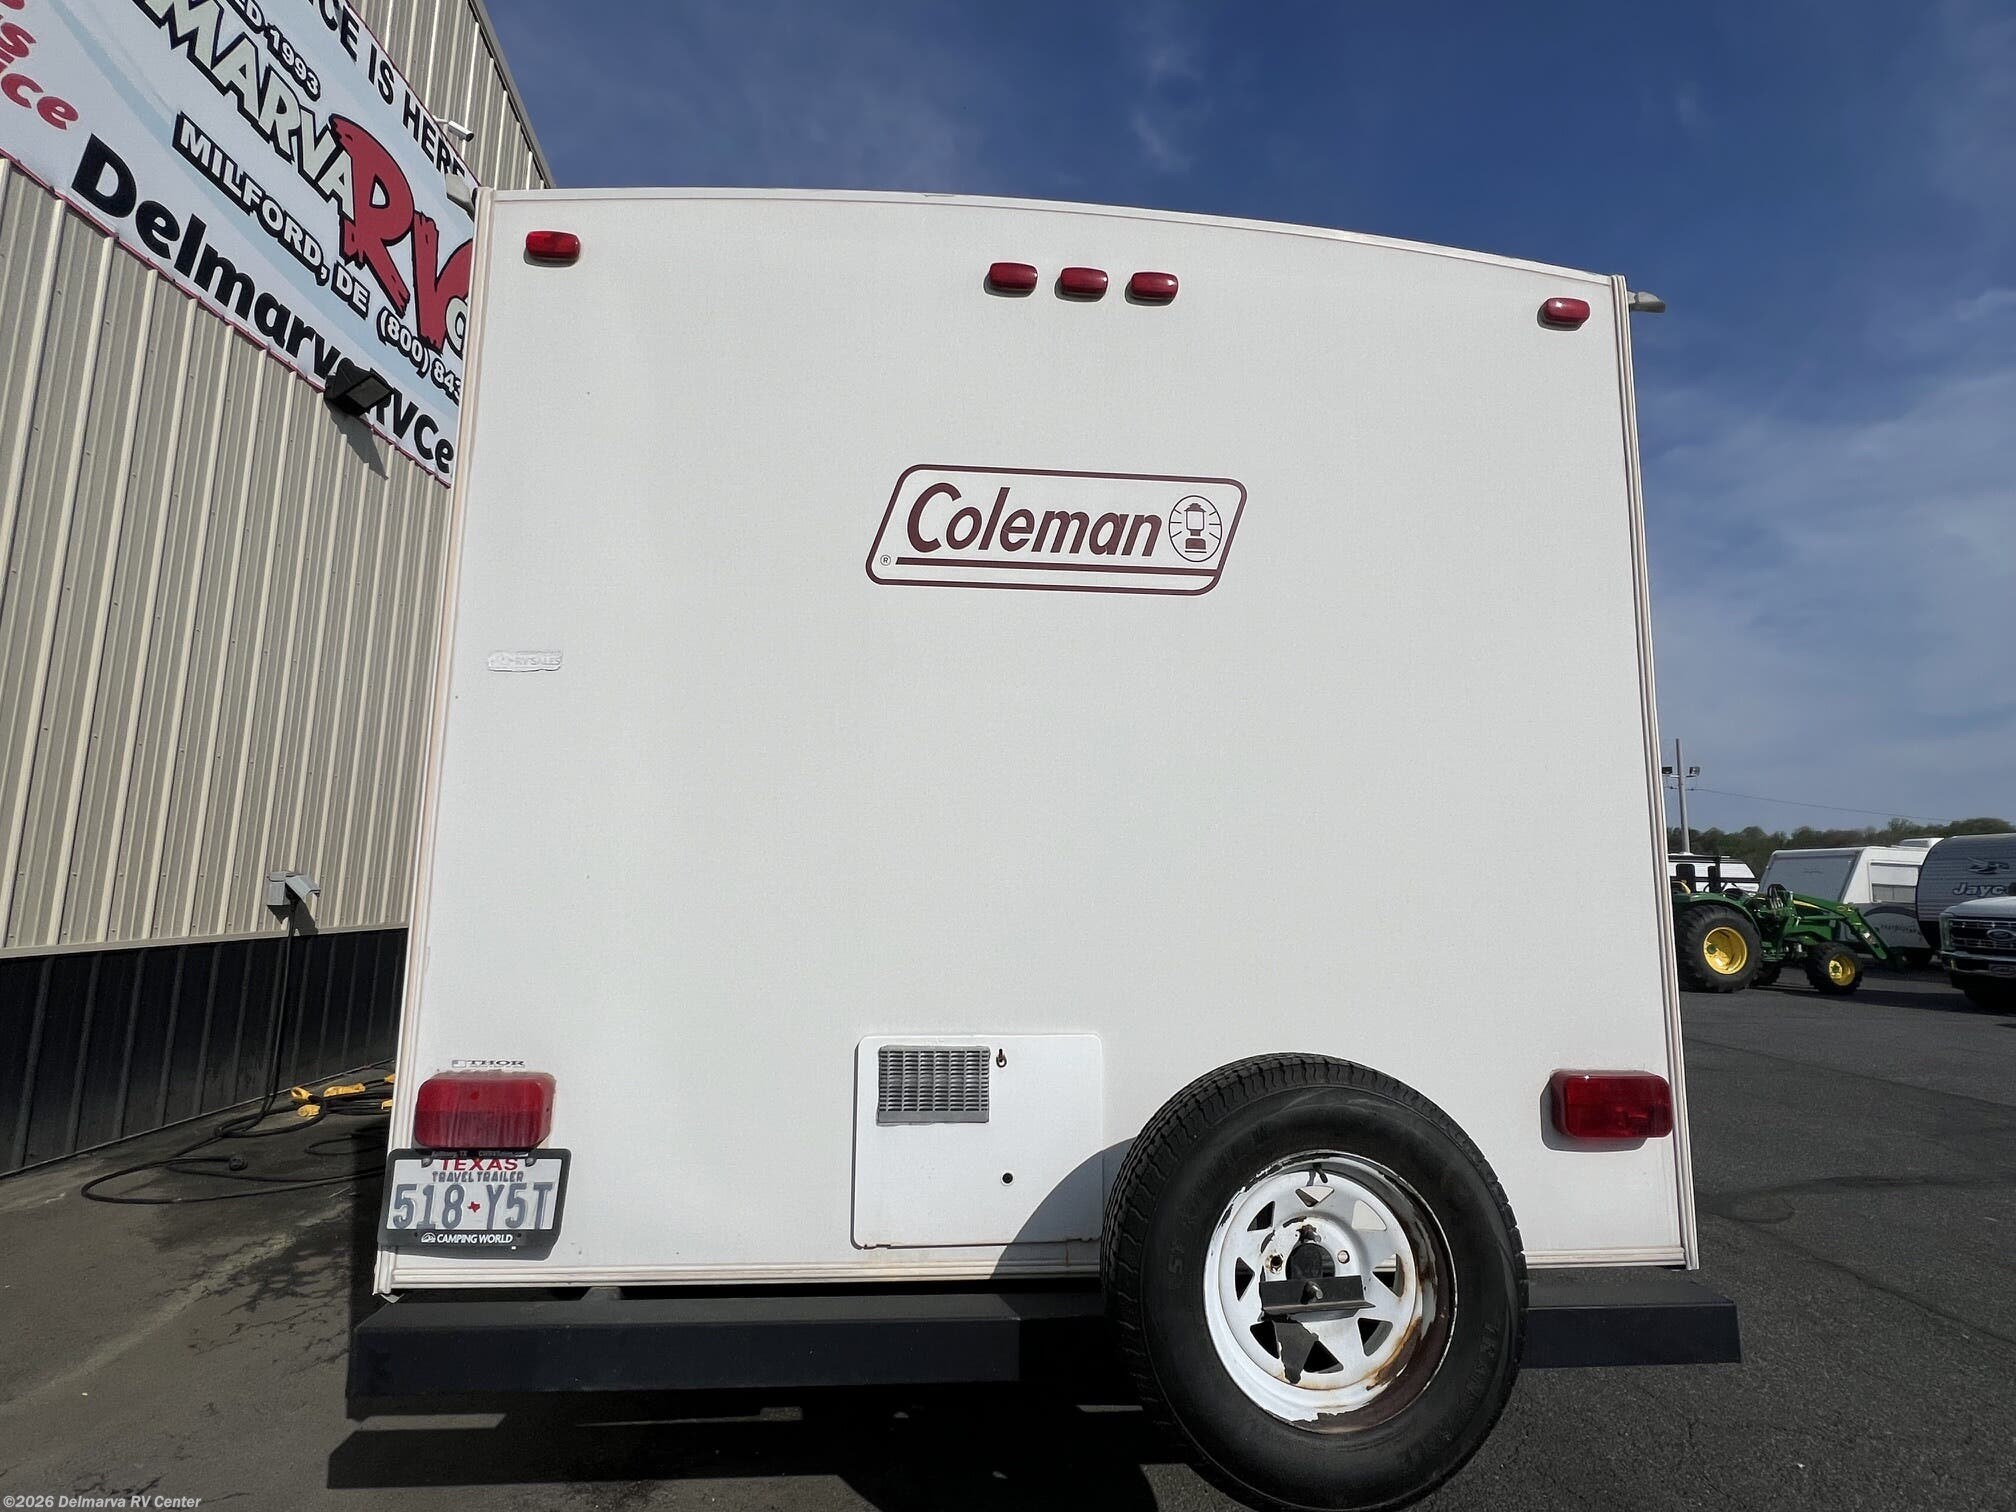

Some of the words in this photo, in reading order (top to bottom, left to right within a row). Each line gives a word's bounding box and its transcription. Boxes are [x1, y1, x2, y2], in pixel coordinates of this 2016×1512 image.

[0, 48, 79, 131] ce
[267, 24, 320, 101] 1993
[368, 43, 394, 105] IS
[173, 112, 329, 285] MILFORD,
[332, 261, 370, 319] DE
[376, 306, 430, 378] (800)
[907, 482, 1163, 557] Coleman
[1952, 882, 2008, 897] Jayc
[432, 1171, 474, 1182] TRAVEL
[477, 1171, 524, 1182] TRAILER
[441, 1158, 519, 1171] TEXAS
[392, 1184, 465, 1229] 518
[486, 1183, 553, 1229] Y5T
[437, 1233, 478, 1243] CAMPING
[479, 1233, 513, 1243] WORLD
